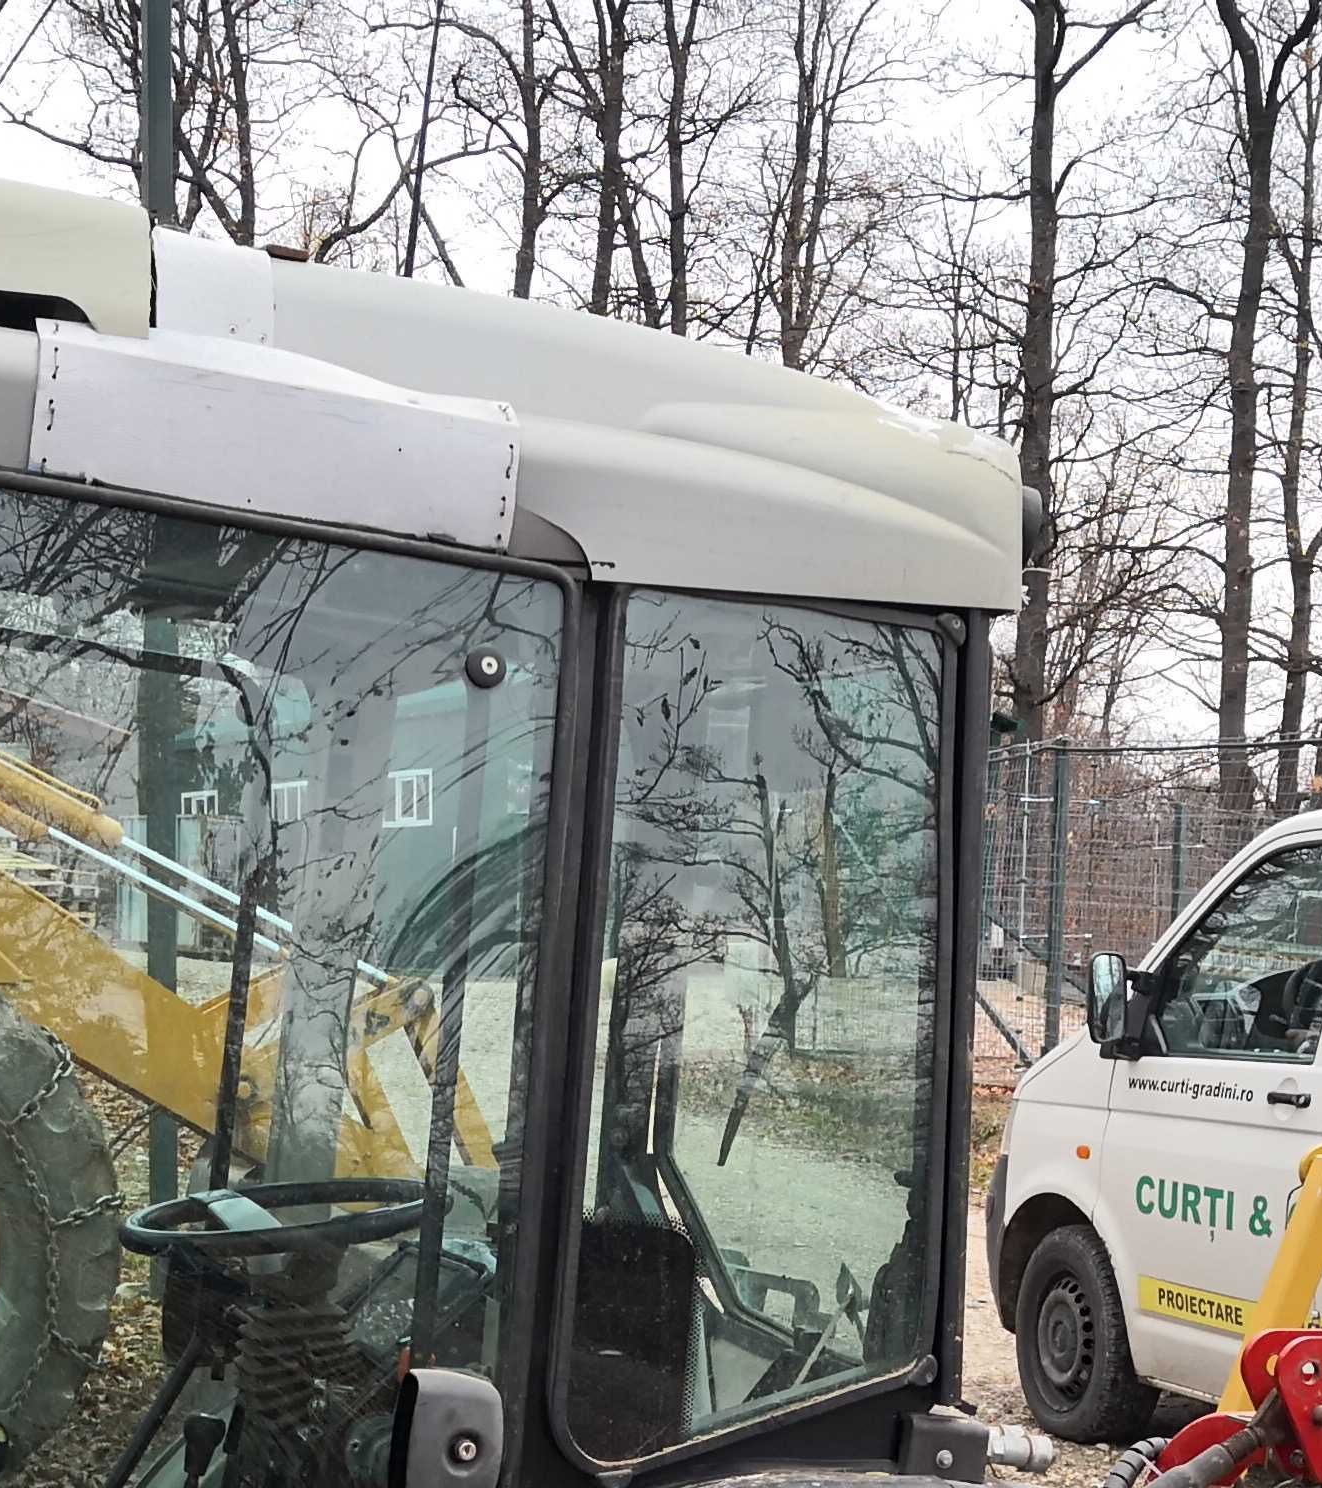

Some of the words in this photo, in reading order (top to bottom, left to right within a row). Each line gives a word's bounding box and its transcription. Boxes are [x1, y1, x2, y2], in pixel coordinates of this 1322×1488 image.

[1128, 1077, 1254, 1102] www.curti-gradini.ro
[1248, 1195, 1273, 1238] &
[1158, 1287, 1244, 1327] PROIECTARE
